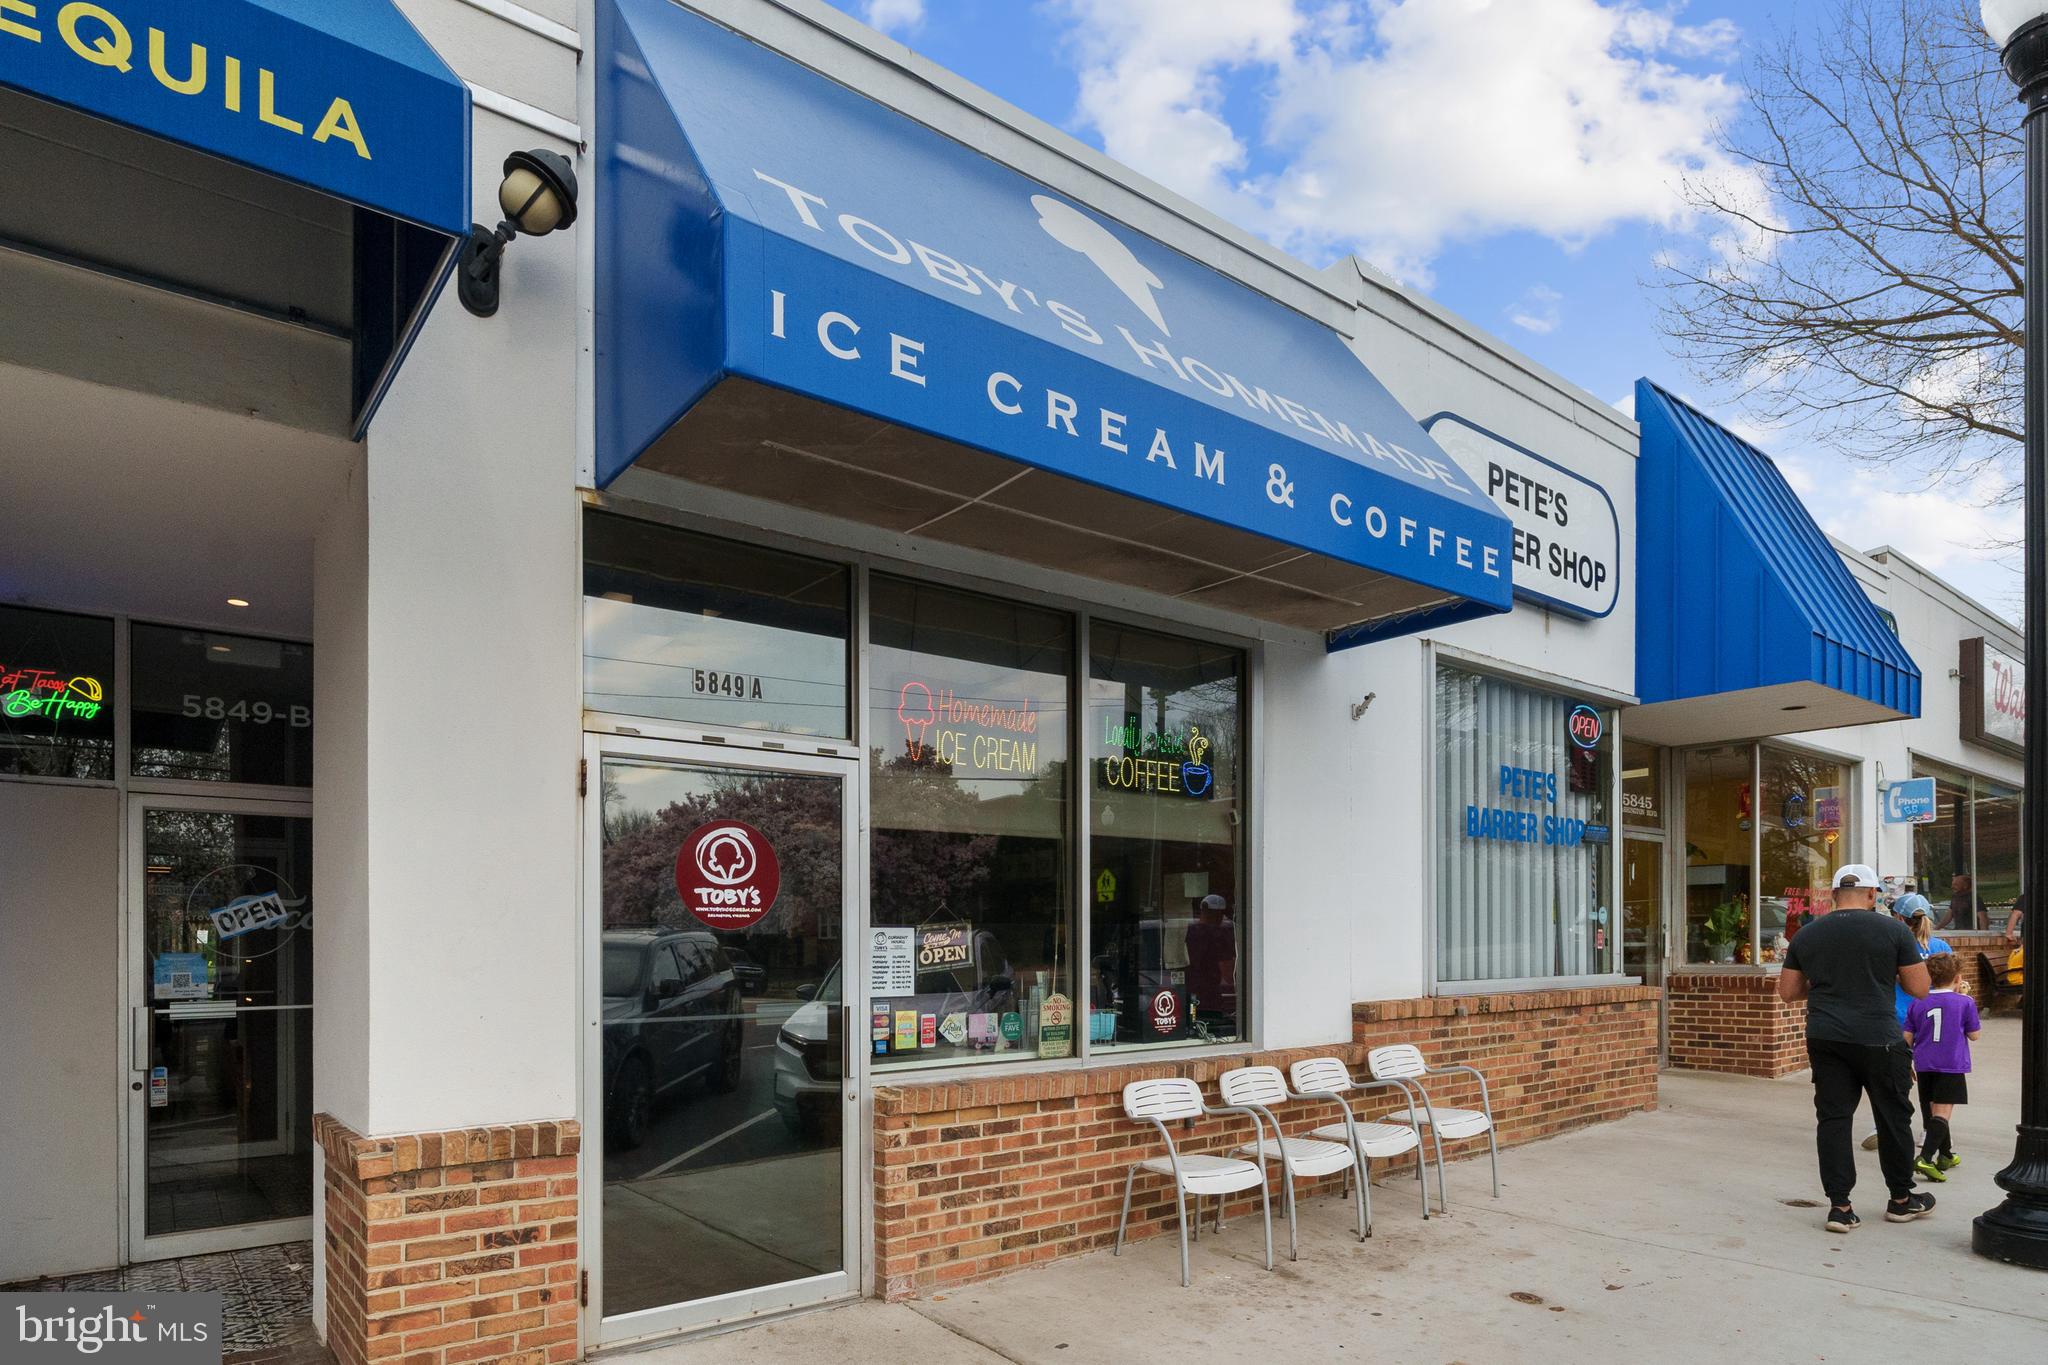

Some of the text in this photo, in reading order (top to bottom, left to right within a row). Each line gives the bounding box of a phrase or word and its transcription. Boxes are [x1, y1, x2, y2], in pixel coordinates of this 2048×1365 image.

[752, 168, 1473, 496] TOBY'S HOMEMADE
[770, 289, 1500, 578] ICE CREAM & COFFEE
[1488, 461, 1569, 527] PETE'S
[1547, 541, 1607, 592] SHOP
[23, 669, 67, 692] Tacos
[694, 669, 763, 700] 5849 A
[6, 688, 101, 720] Be Happy
[182, 693, 312, 729] 5849-B
[938, 688, 1038, 734] Homemade
[1570, 714, 1600, 739] OPEN
[935, 729, 1037, 775] ICE CREAM
[1106, 754, 1181, 793] COFFEE
[1500, 763, 1558, 804] PETE'S
[1622, 792, 1654, 810] 5845
[1897, 796, 1930, 806] Phone
[1466, 805, 1587, 848] BARBER SHOP
[693, 885, 762, 906] TOBY'S
[216, 896, 283, 933] OPEN
[919, 944, 967, 965] OPEN
[923, 932, 949, 945] Come
[1004, 1024, 1020, 1032] FAVE
[1154, 1015, 1177, 1026] TOBY'S
[1926, 1007, 1943, 1043] 1
